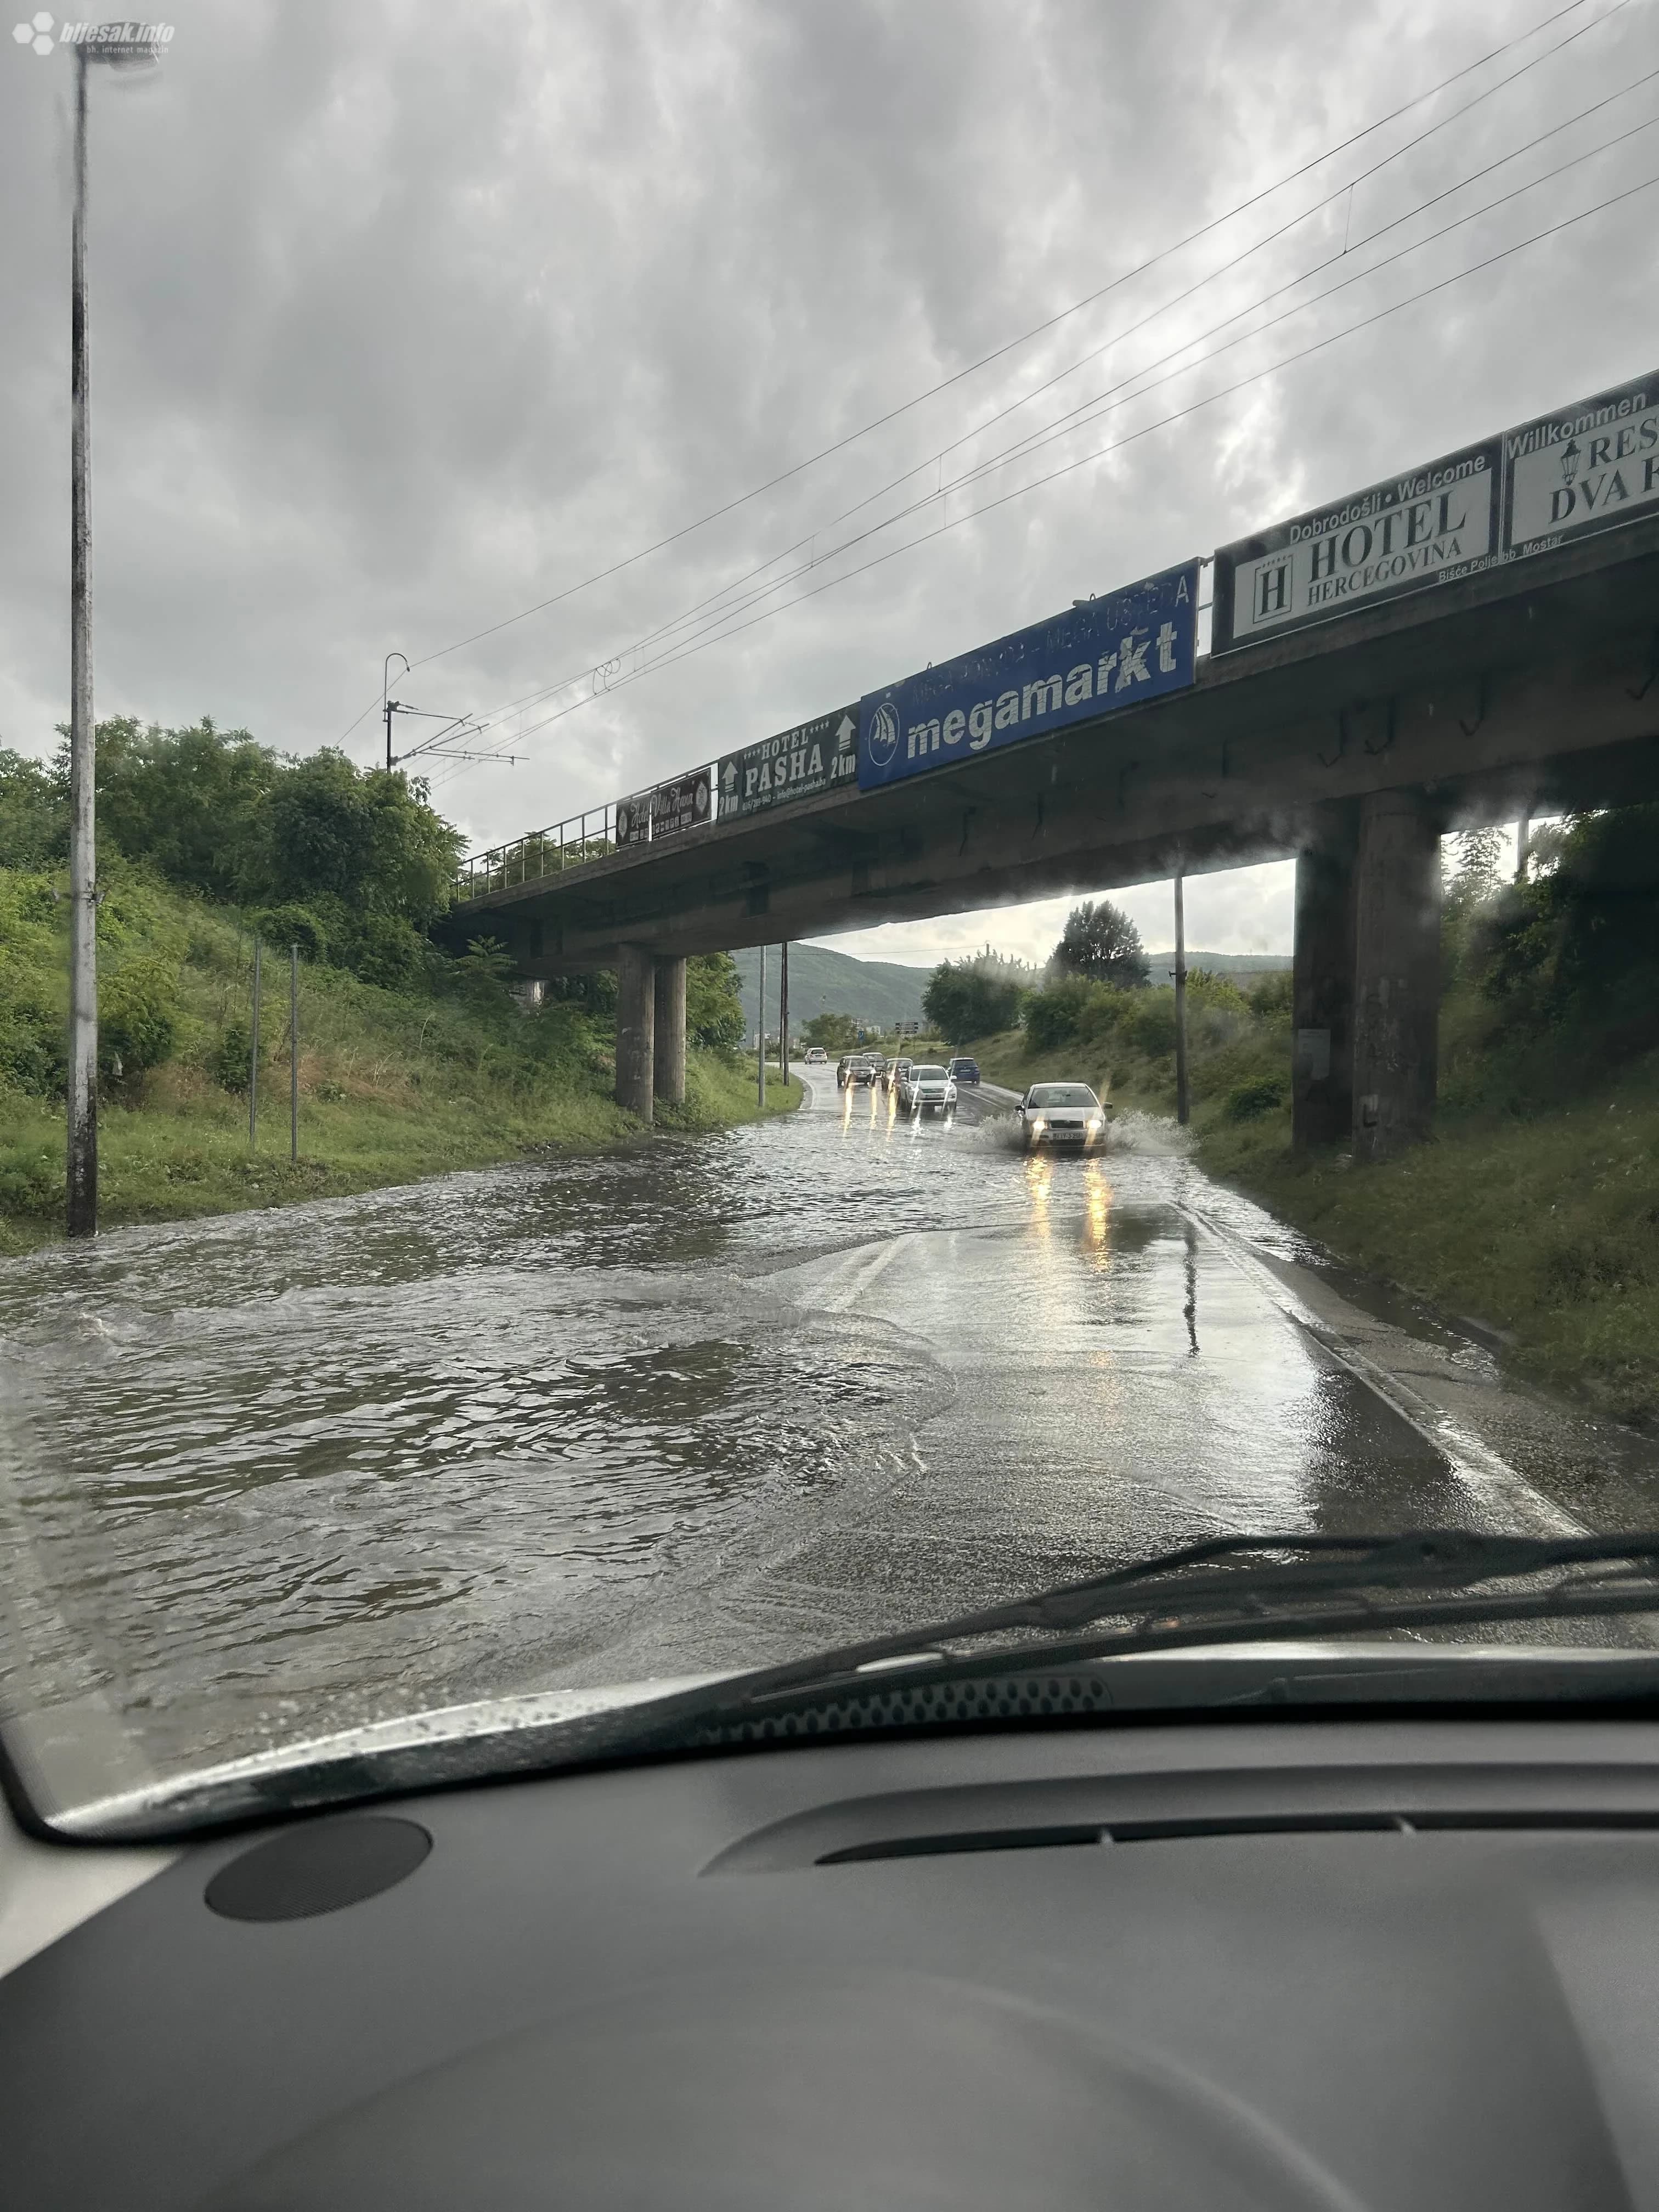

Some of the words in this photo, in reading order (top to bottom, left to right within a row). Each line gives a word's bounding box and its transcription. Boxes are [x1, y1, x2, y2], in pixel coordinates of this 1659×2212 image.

[1508, 392, 1646, 460] Willkommen
[1290, 494, 1381, 545] Dobrodošli
[1397, 455, 1486, 503] Welcome
[1549, 470, 1630, 524] DVA
[1308, 490, 1467, 583] HOTEL
[1471, 554, 1497, 572] Polje
[1523, 535, 1563, 555] Mostar
[1259, 565, 1288, 616] H
[1308, 537, 1462, 606] HERCEGOVINA
[907, 621, 1178, 760] megamarkt
[746, 743, 823, 797] PASHA
[761, 728, 809, 760] HOTEL
